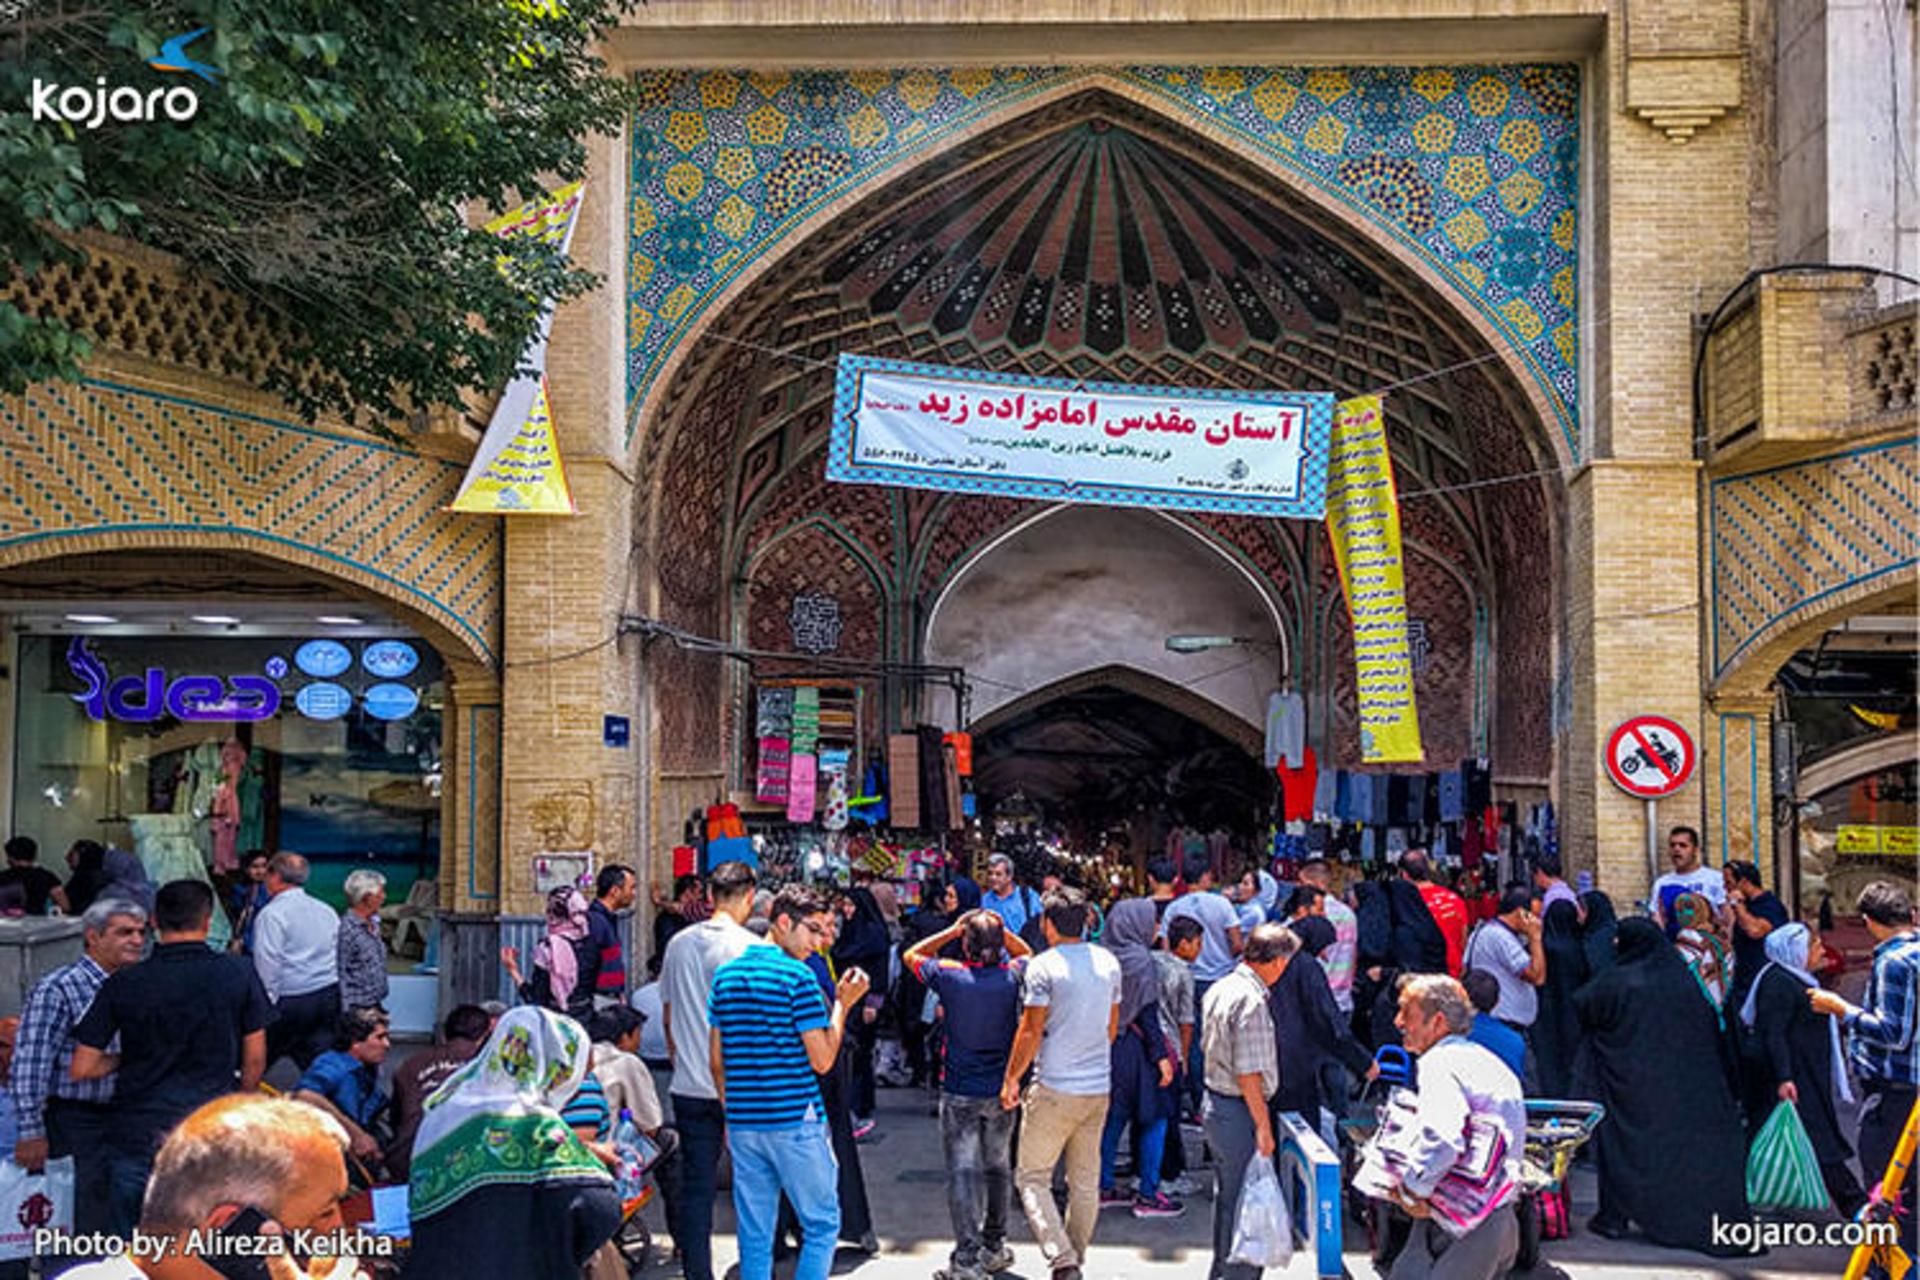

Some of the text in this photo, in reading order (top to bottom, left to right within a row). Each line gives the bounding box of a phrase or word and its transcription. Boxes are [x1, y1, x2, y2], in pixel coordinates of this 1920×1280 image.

[918, 391, 970, 426] زید
[978, 393, 1098, 431] امامزاده
[1104, 406, 1197, 437] مقدس
[1205, 411, 1299, 447] آستان
